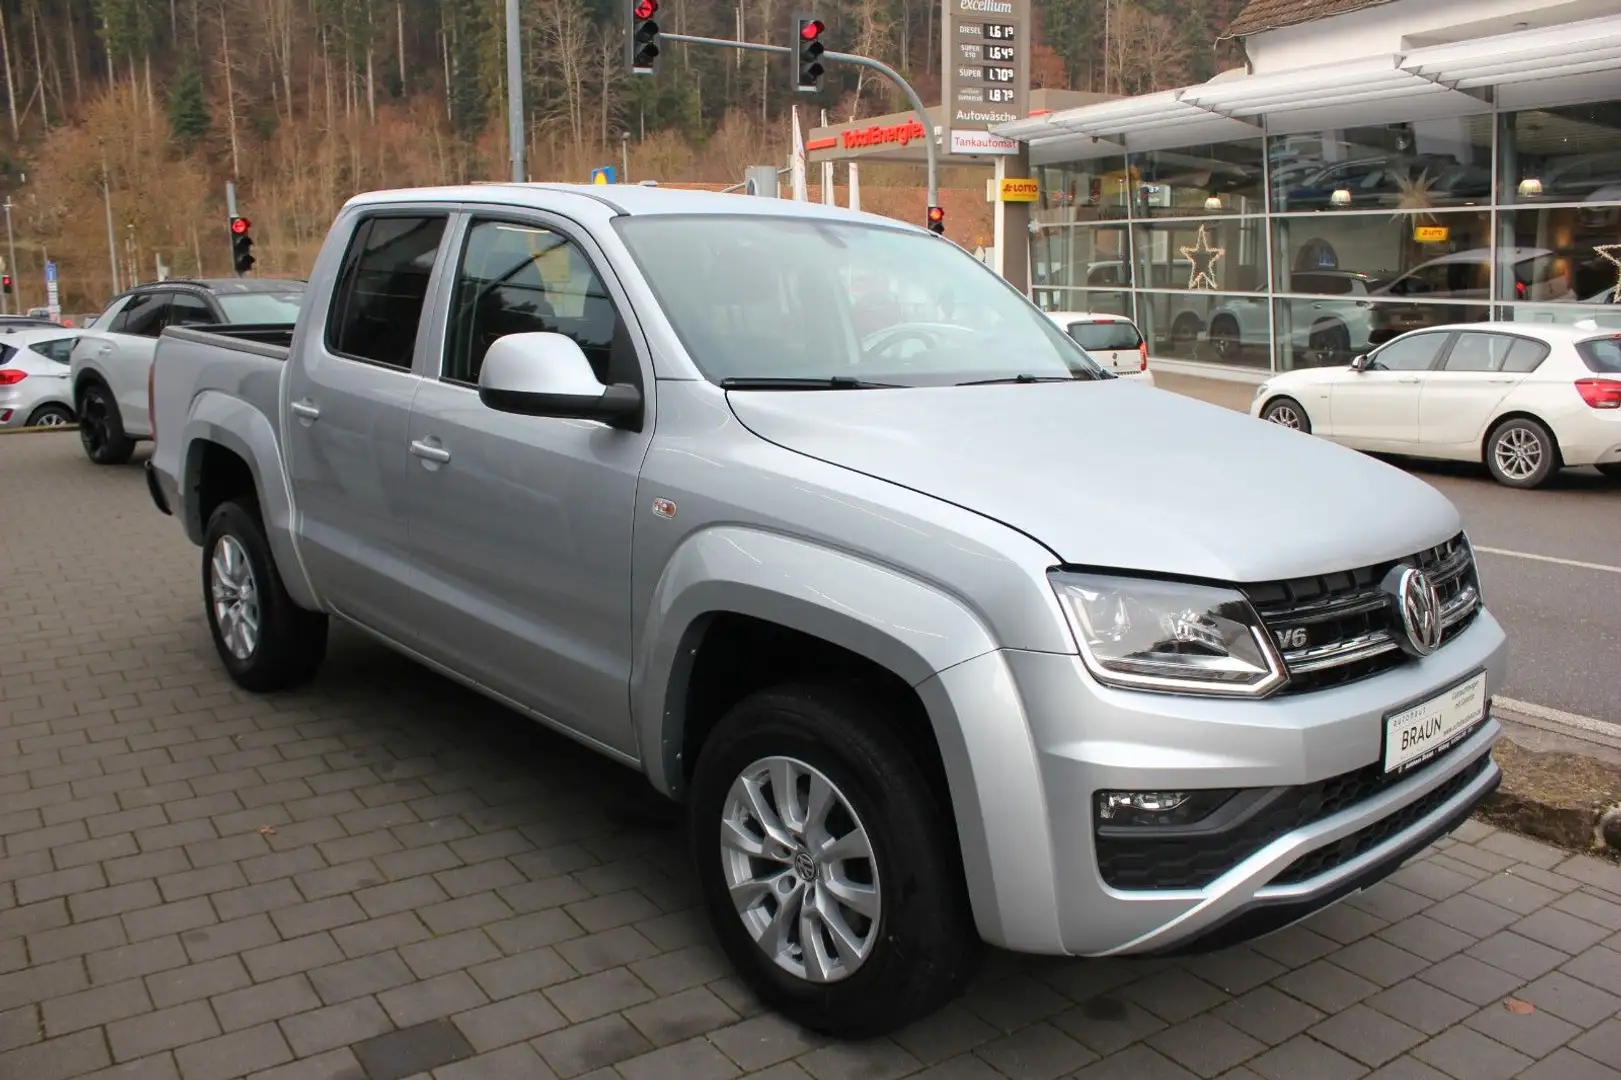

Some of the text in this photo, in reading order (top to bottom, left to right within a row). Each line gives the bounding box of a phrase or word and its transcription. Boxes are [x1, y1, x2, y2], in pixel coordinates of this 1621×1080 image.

[960, 0, 1012, 13] excellium
[959, 25, 982, 35] DIESEL
[960, 44, 980, 52] SUPER
[959, 68, 982, 78] SUPER
[956, 109, 1017, 122] Autowäsche
[955, 137, 1017, 149] Tankautomat
[1013, 183, 1038, 193] LOTTO
[1274, 627, 1307, 648] V6
[1401, 714, 1442, 751] BRAUN
